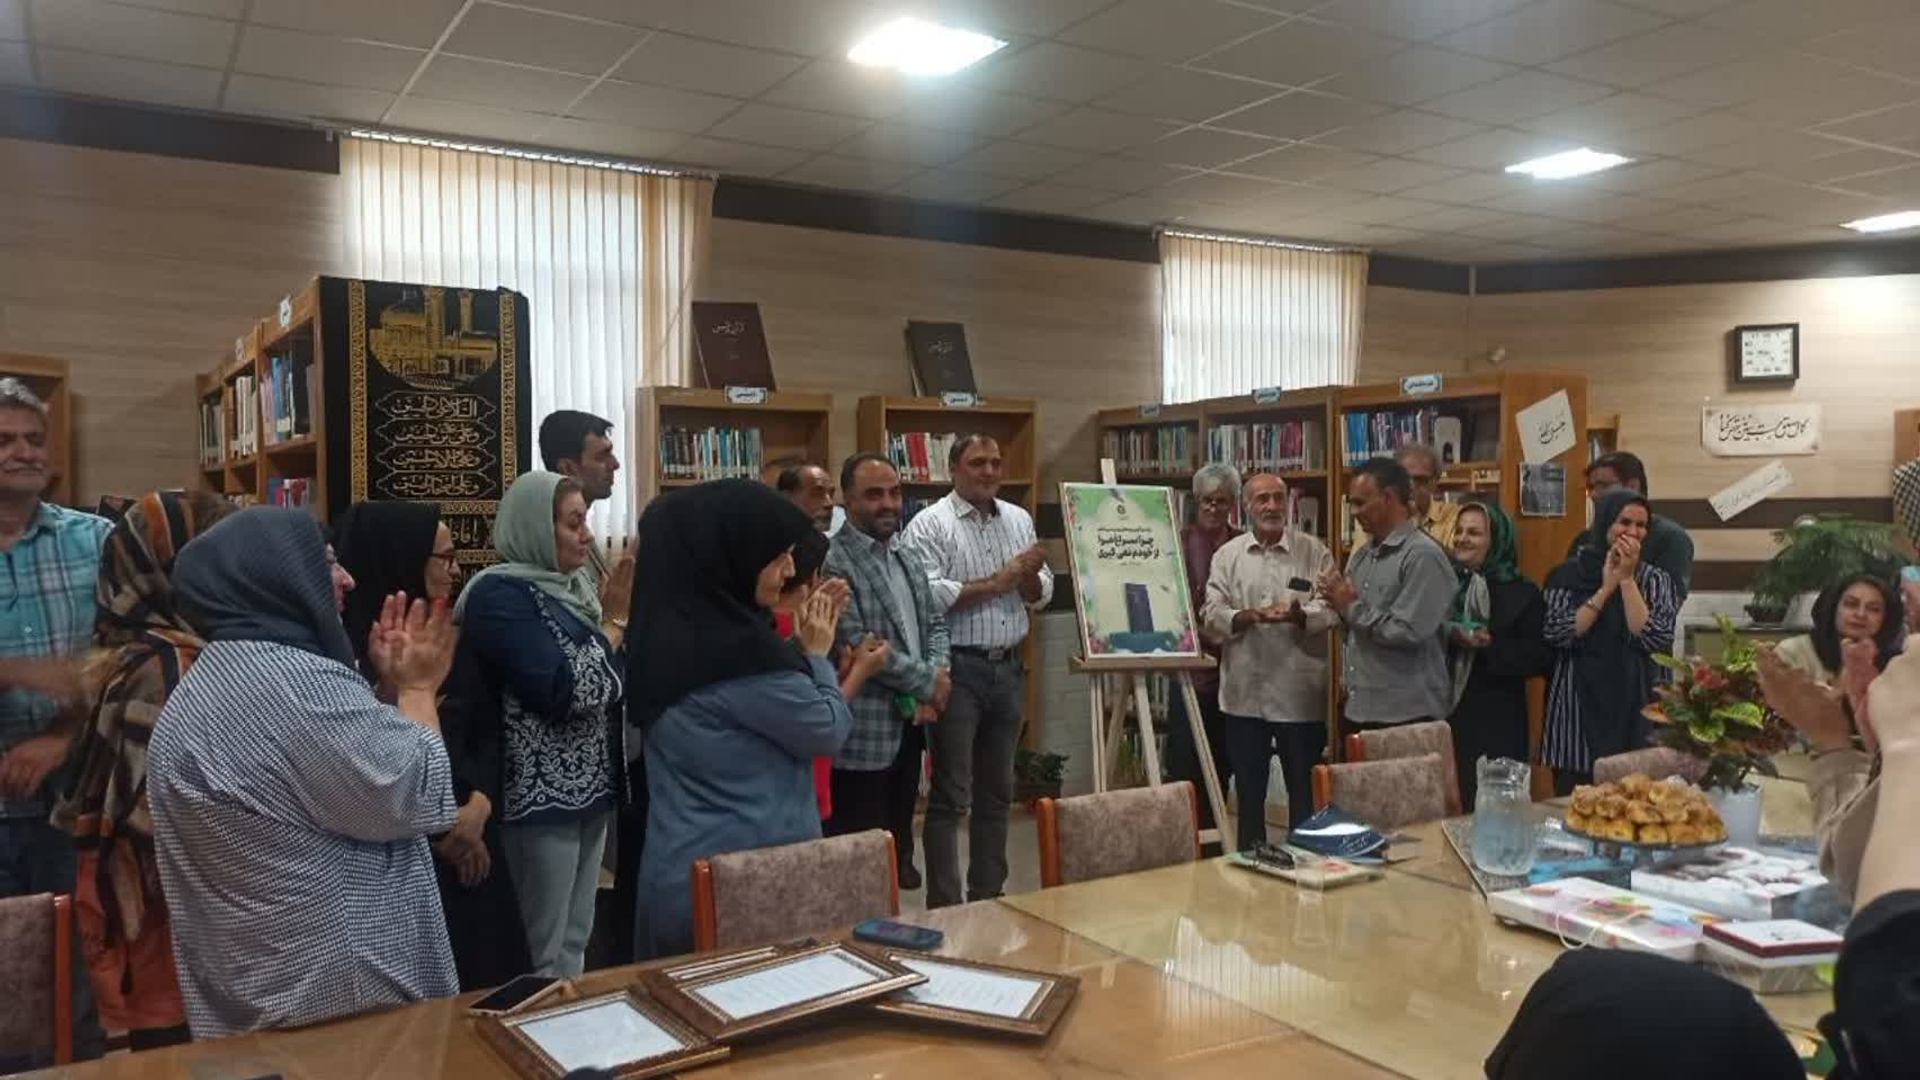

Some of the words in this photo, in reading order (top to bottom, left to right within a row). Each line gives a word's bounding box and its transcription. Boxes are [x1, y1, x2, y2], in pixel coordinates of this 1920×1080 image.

[1098, 534, 1114, 546] مرا
[1114, 533, 1139, 547] سراغ
[1138, 534, 1154, 549] چرا
[1098, 546, 1116, 560] گیری
[1116, 547, 1132, 560] نمی
[1132, 547, 1153, 560] خودم
[1153, 548, 1160, 560] از
